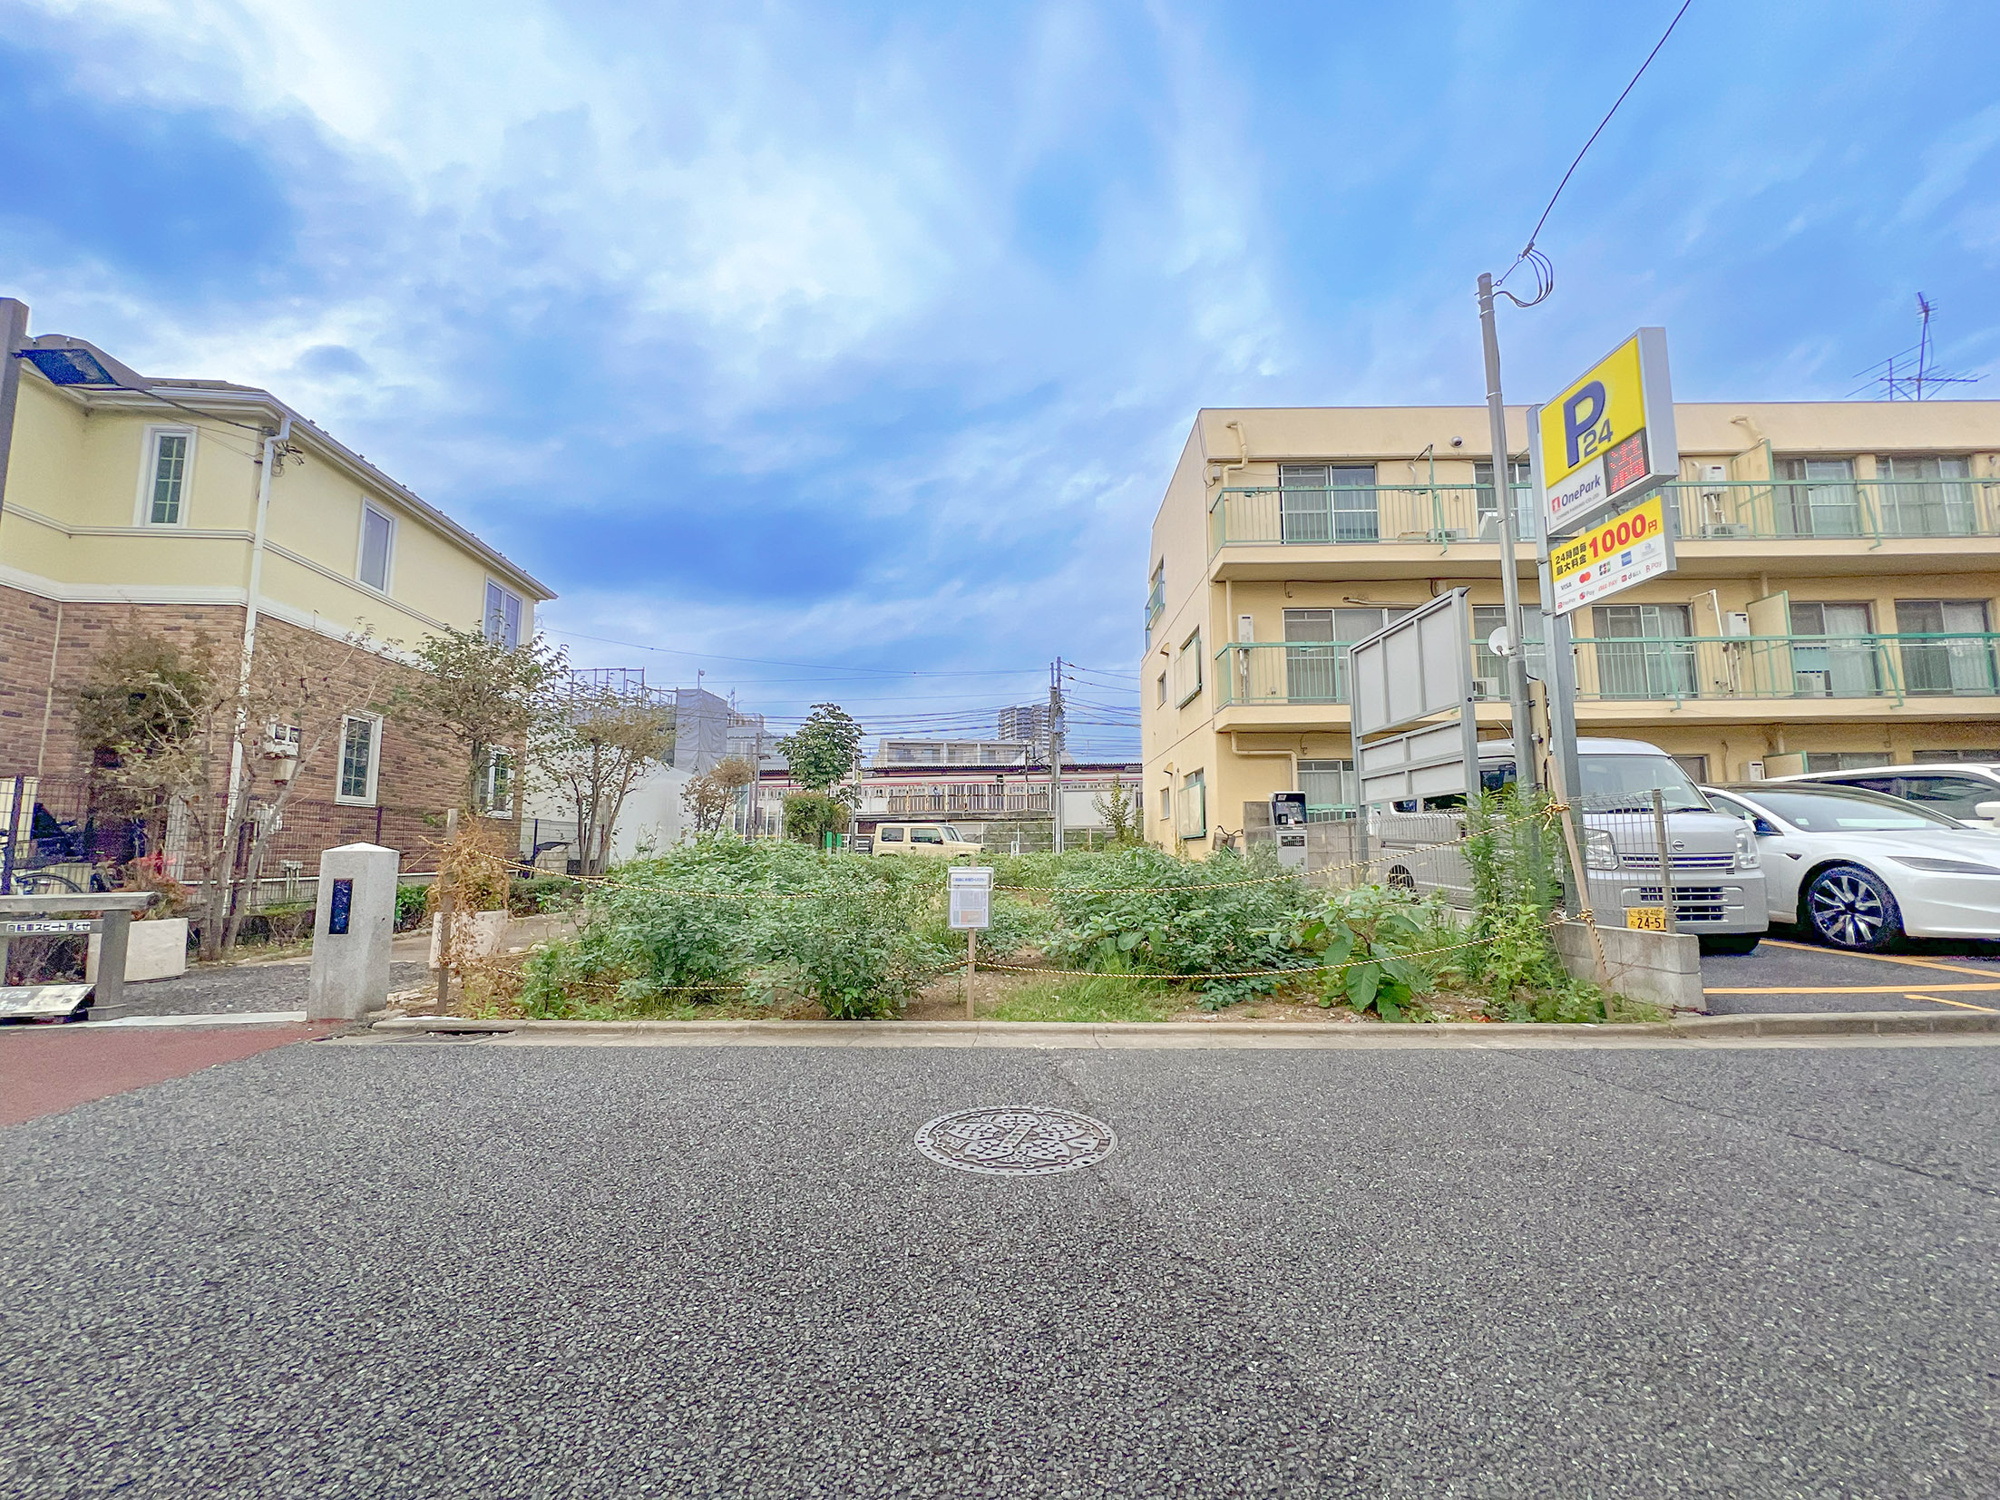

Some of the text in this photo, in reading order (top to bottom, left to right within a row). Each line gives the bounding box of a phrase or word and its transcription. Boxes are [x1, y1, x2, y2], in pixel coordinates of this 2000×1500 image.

[1563, 380, 1606, 469] P
[1583, 418, 1614, 459] 24
[1561, 474, 1601, 507] OnePark
[1556, 554, 1587, 576] 最大料金
